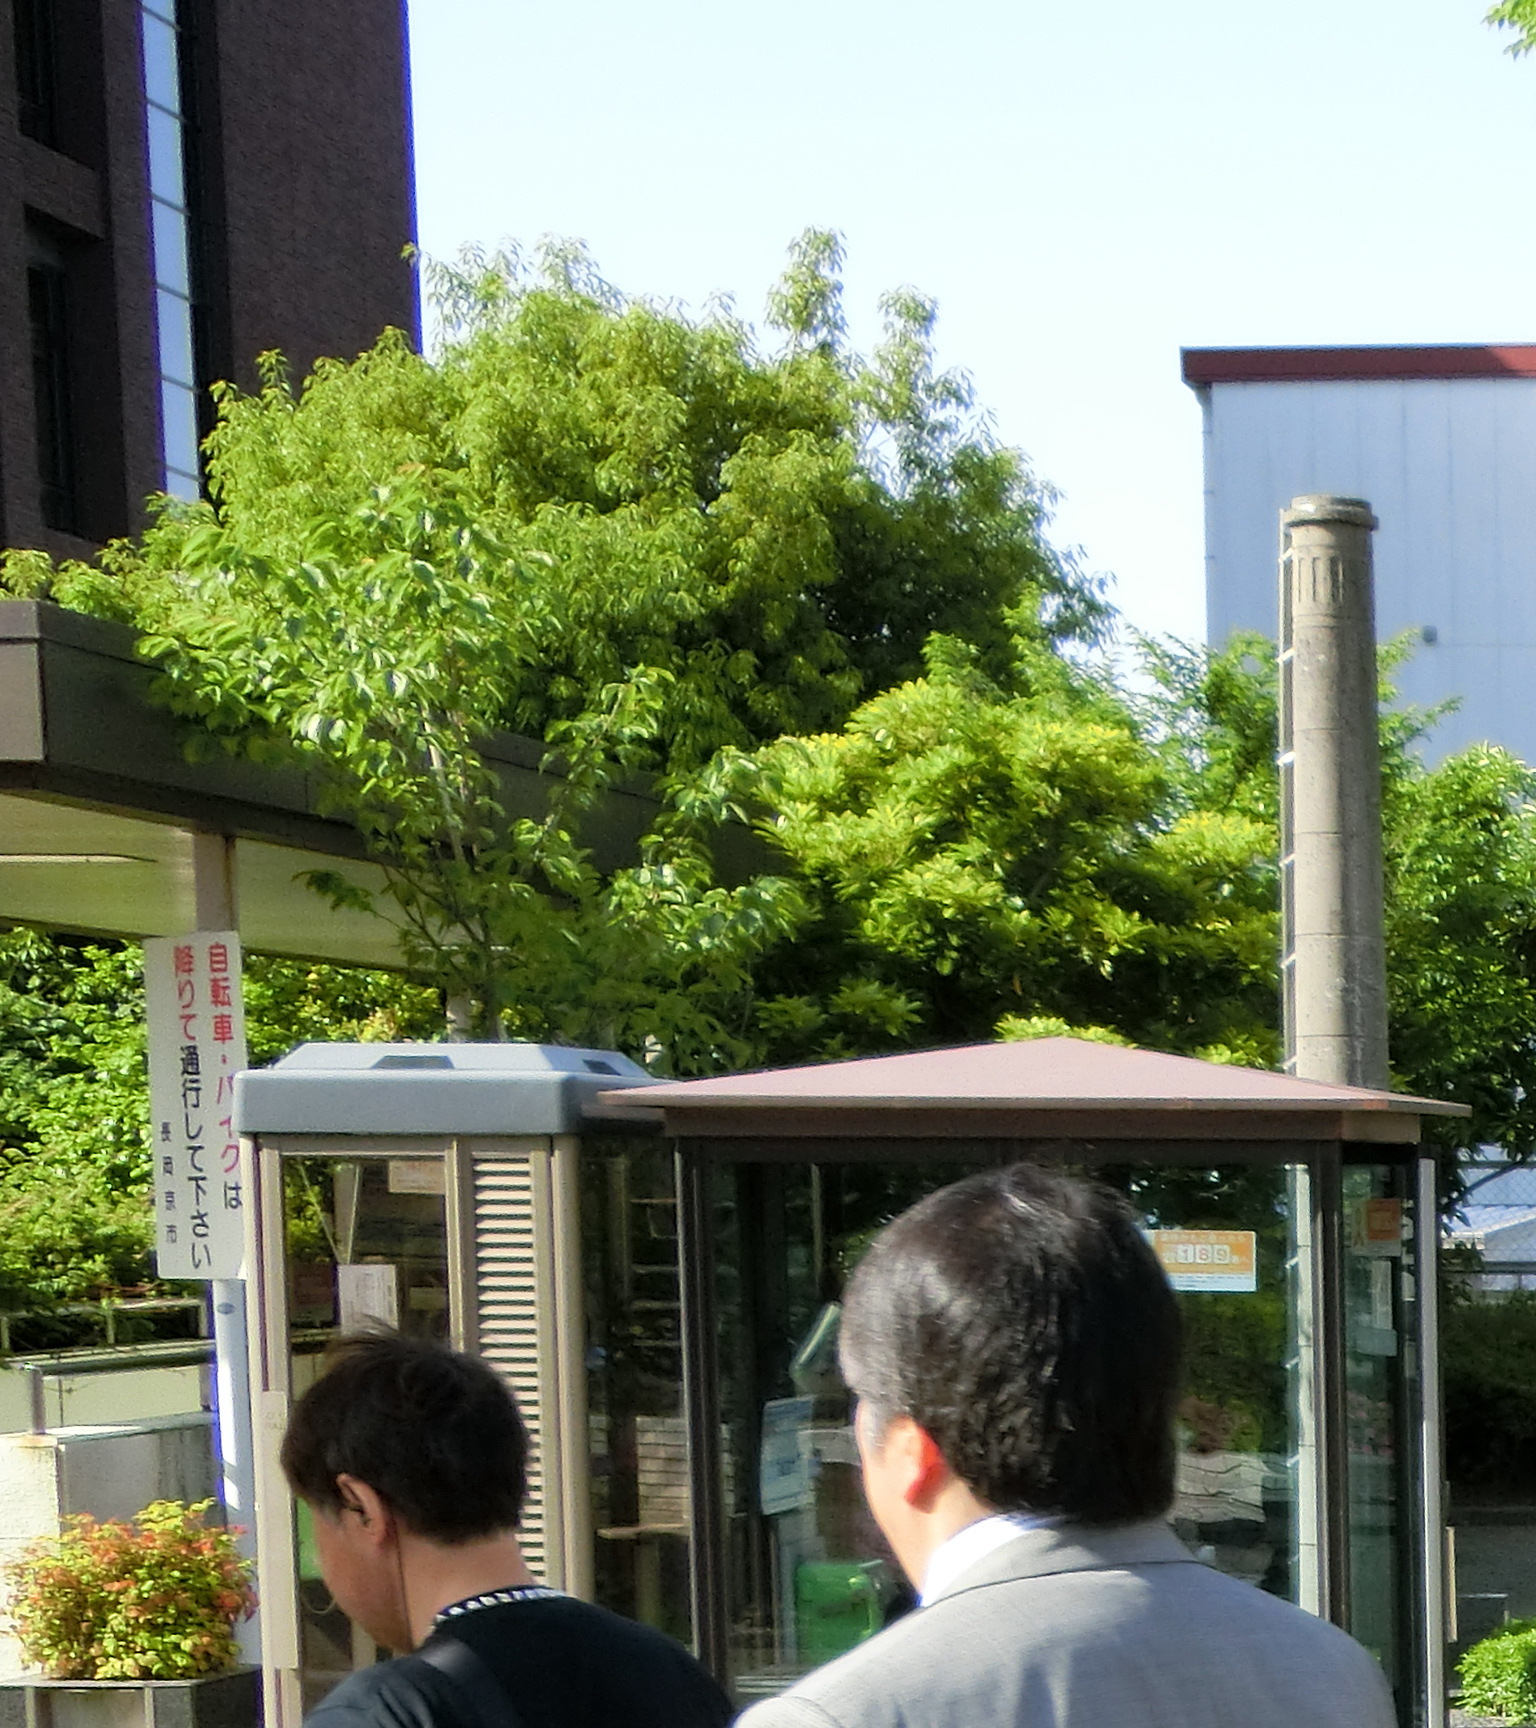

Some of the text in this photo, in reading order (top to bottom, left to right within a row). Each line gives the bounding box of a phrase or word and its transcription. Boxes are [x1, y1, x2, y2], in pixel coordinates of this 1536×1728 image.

[161, 1121, 178, 1245] 長岡京市
[173, 946, 212, 1270] 降りて通行して下さい
